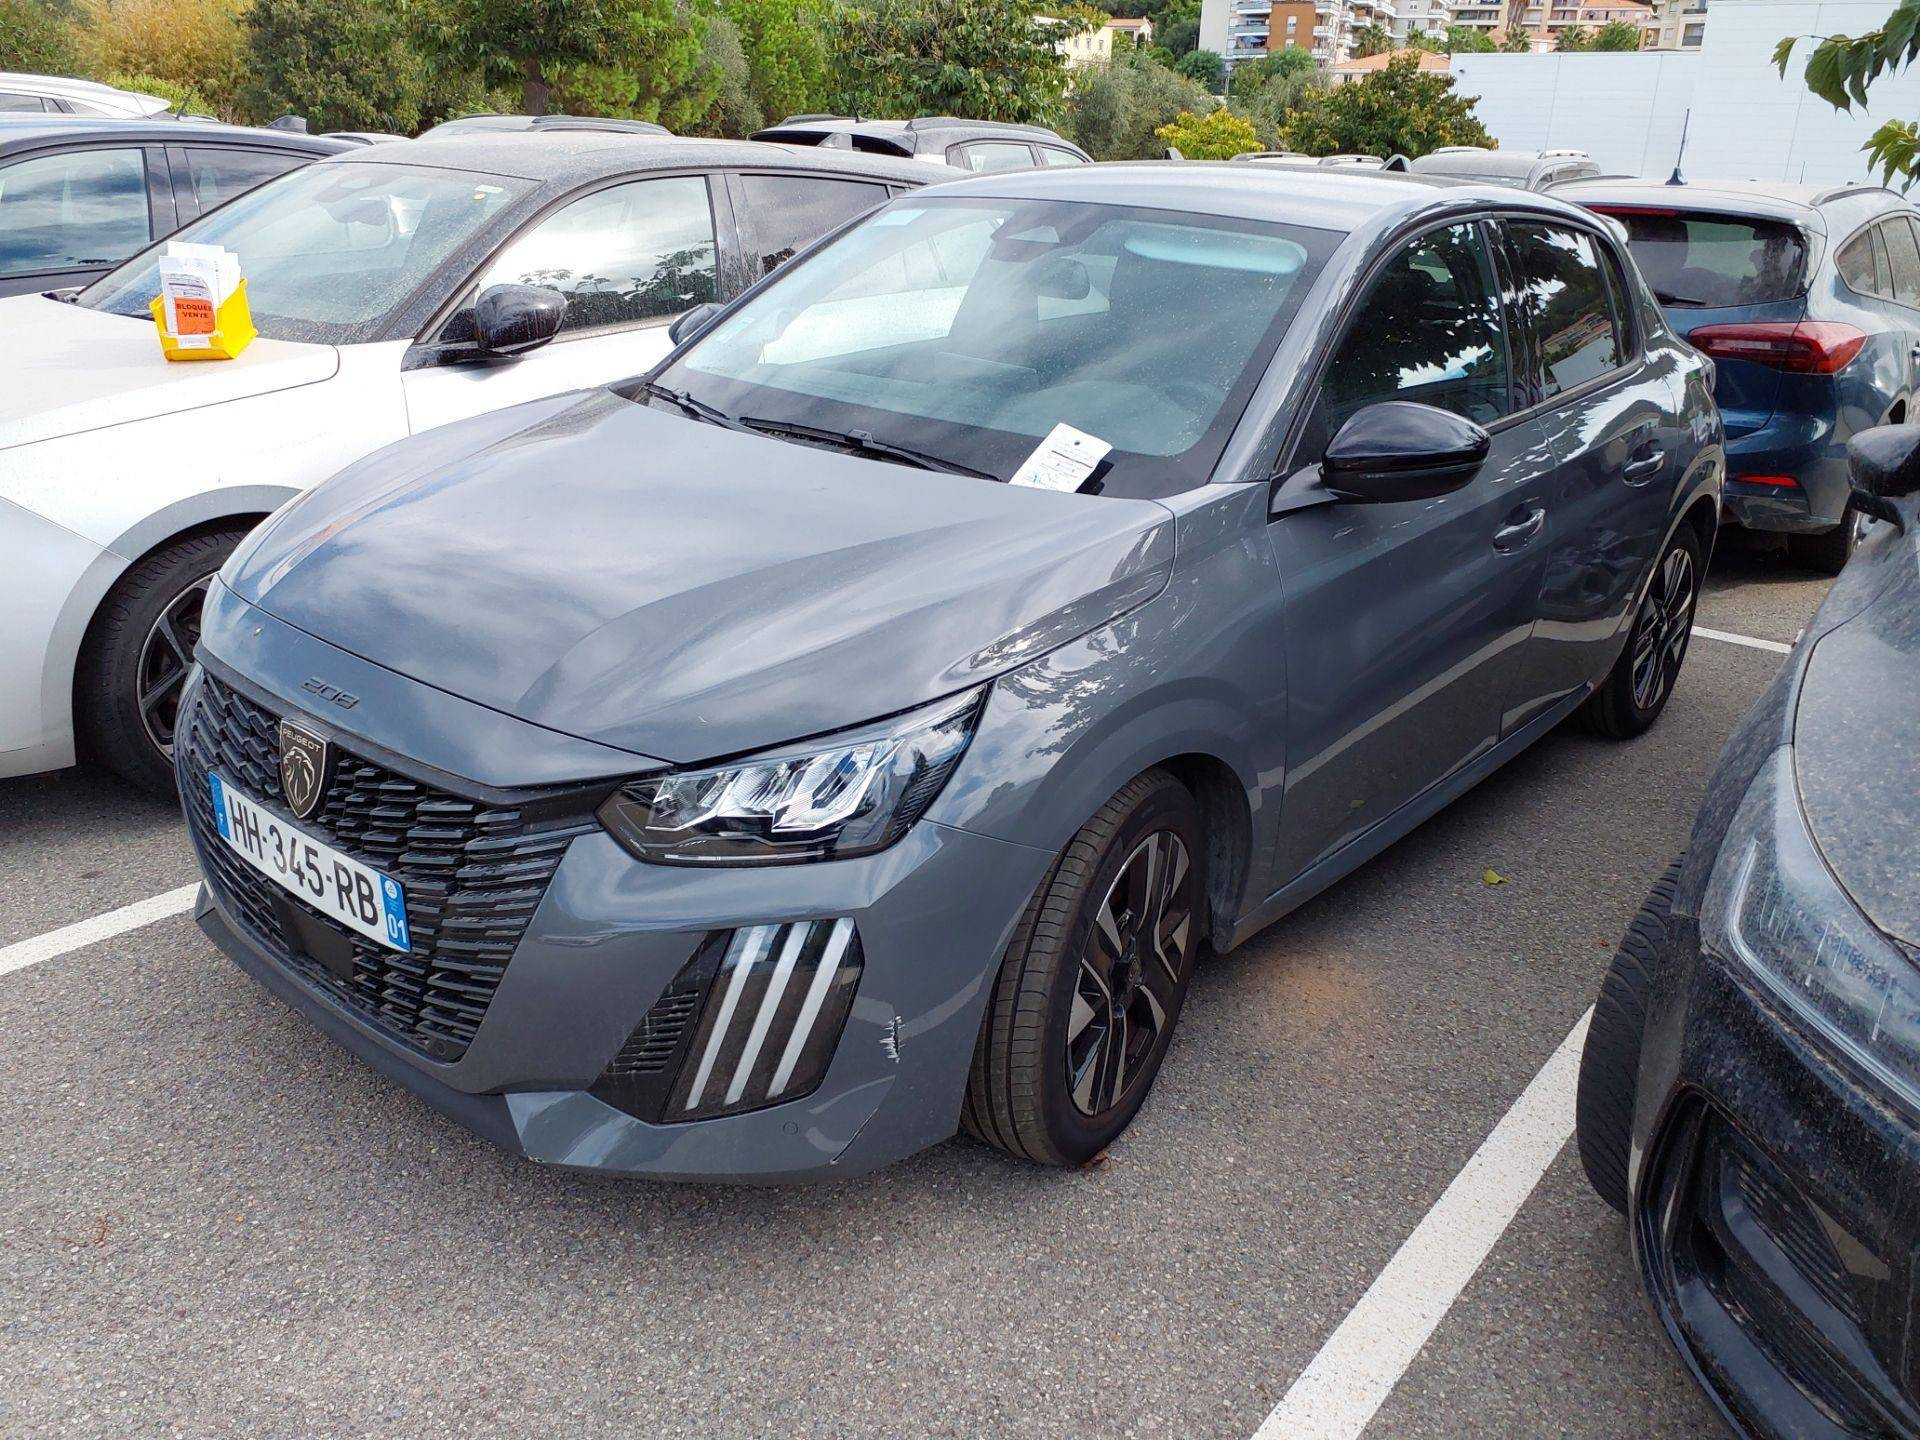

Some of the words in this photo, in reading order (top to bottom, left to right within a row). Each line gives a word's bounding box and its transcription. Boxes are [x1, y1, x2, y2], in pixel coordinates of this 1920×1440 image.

[301, 677, 360, 711] 208
[283, 728, 322, 752] PEUGEOT
[228, 795, 379, 926] HH-345-RB
[387, 913, 408, 944] 01
